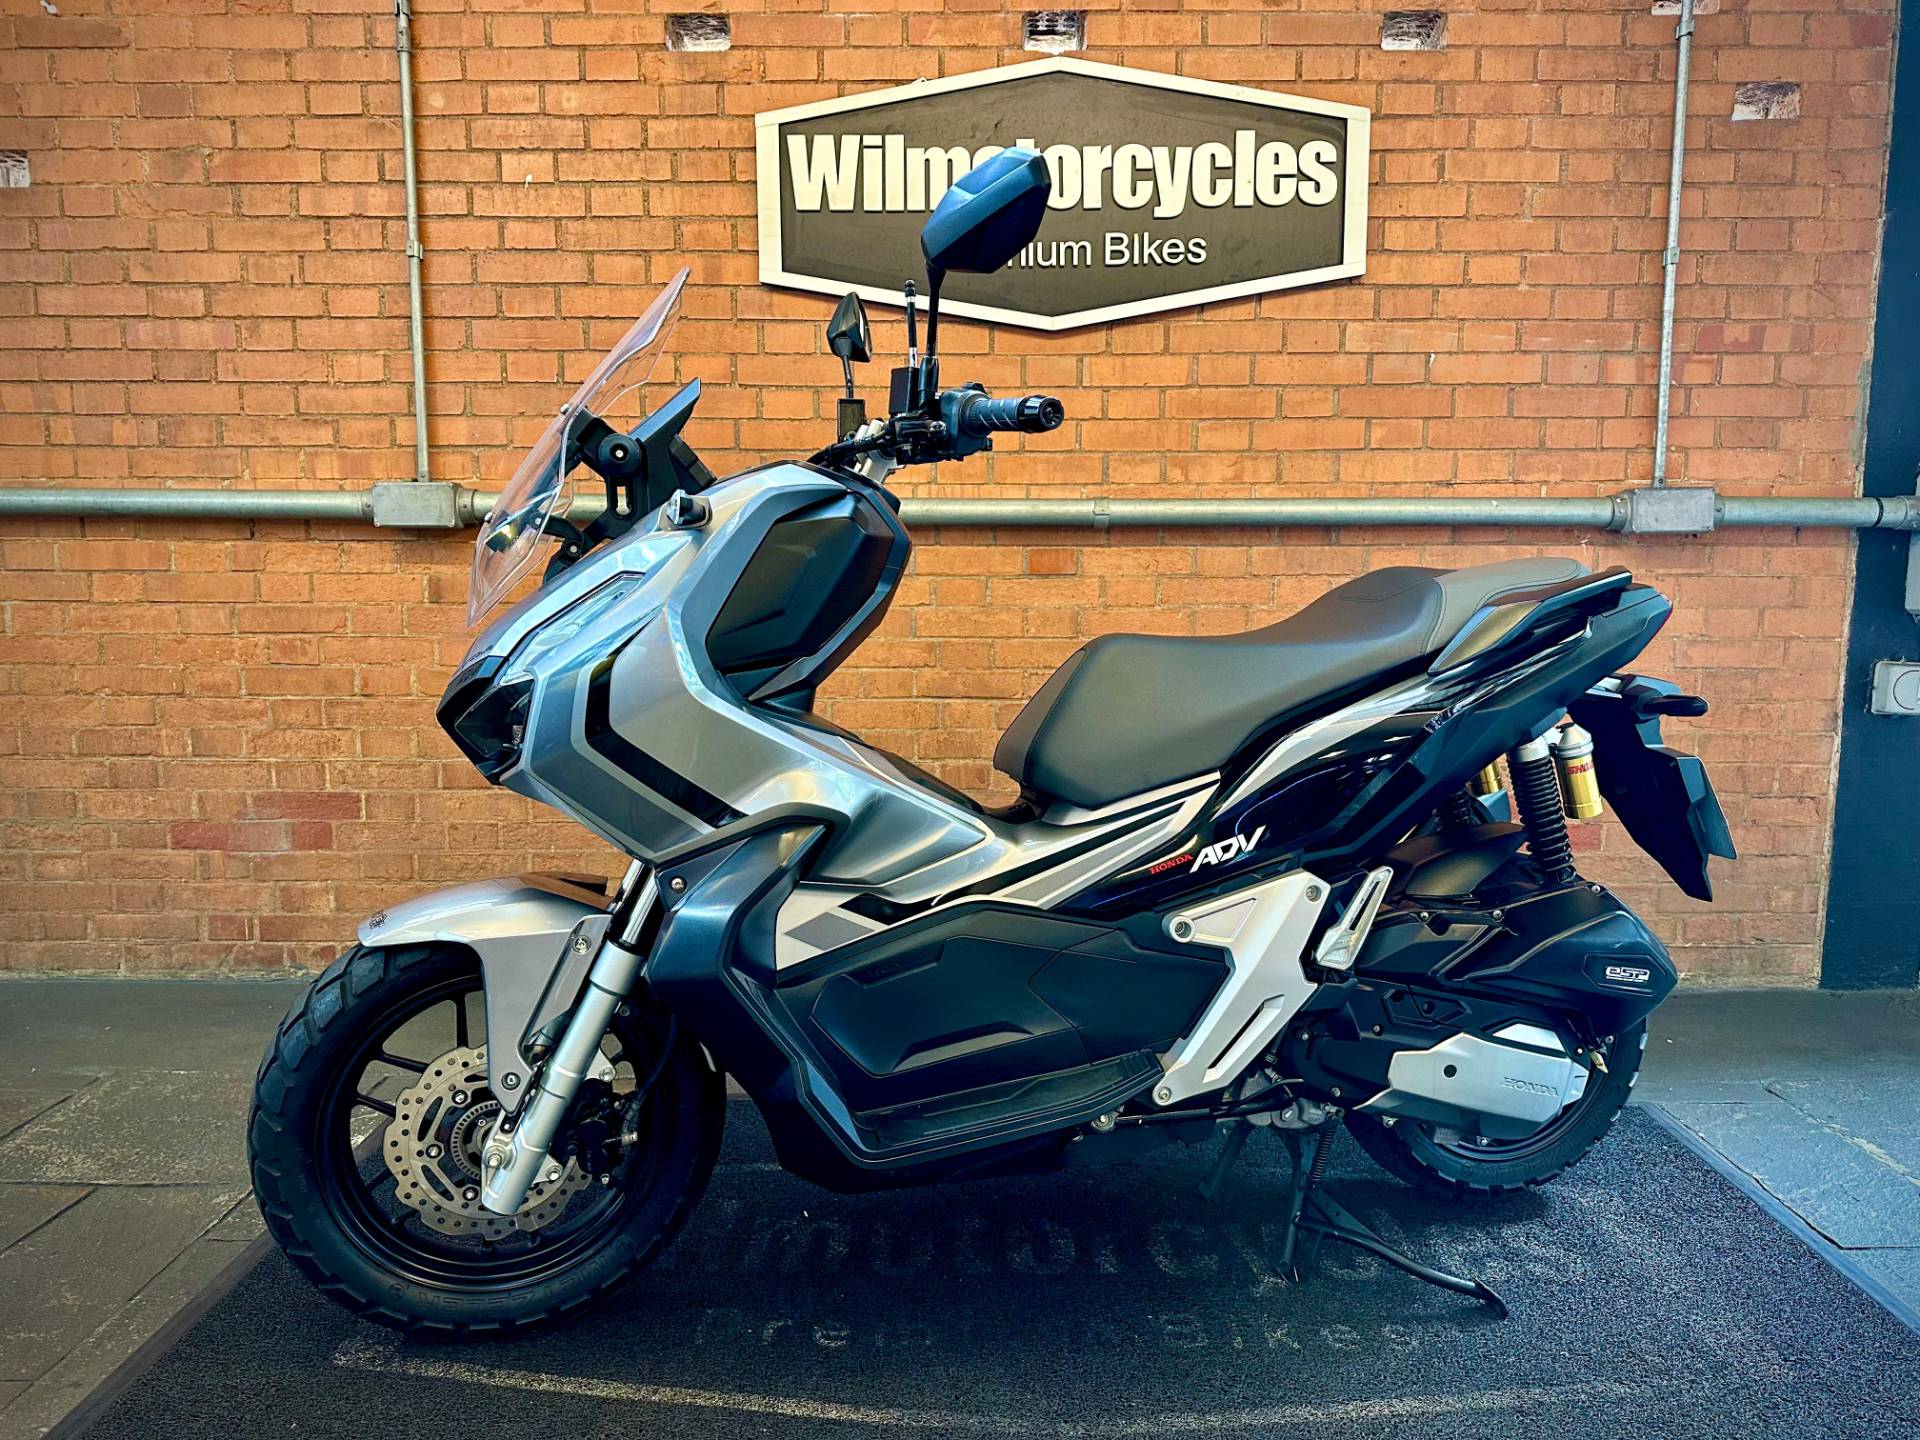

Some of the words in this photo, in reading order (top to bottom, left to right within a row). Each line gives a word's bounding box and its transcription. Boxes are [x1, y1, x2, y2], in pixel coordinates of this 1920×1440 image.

[786, 129, 1339, 219] Wilmorcycles
[1104, 231, 1207, 267] Bikes
[1150, 853, 1193, 875] HONDA
[1189, 824, 1267, 874] ADV
[1501, 1076, 1559, 1097] HONDA
